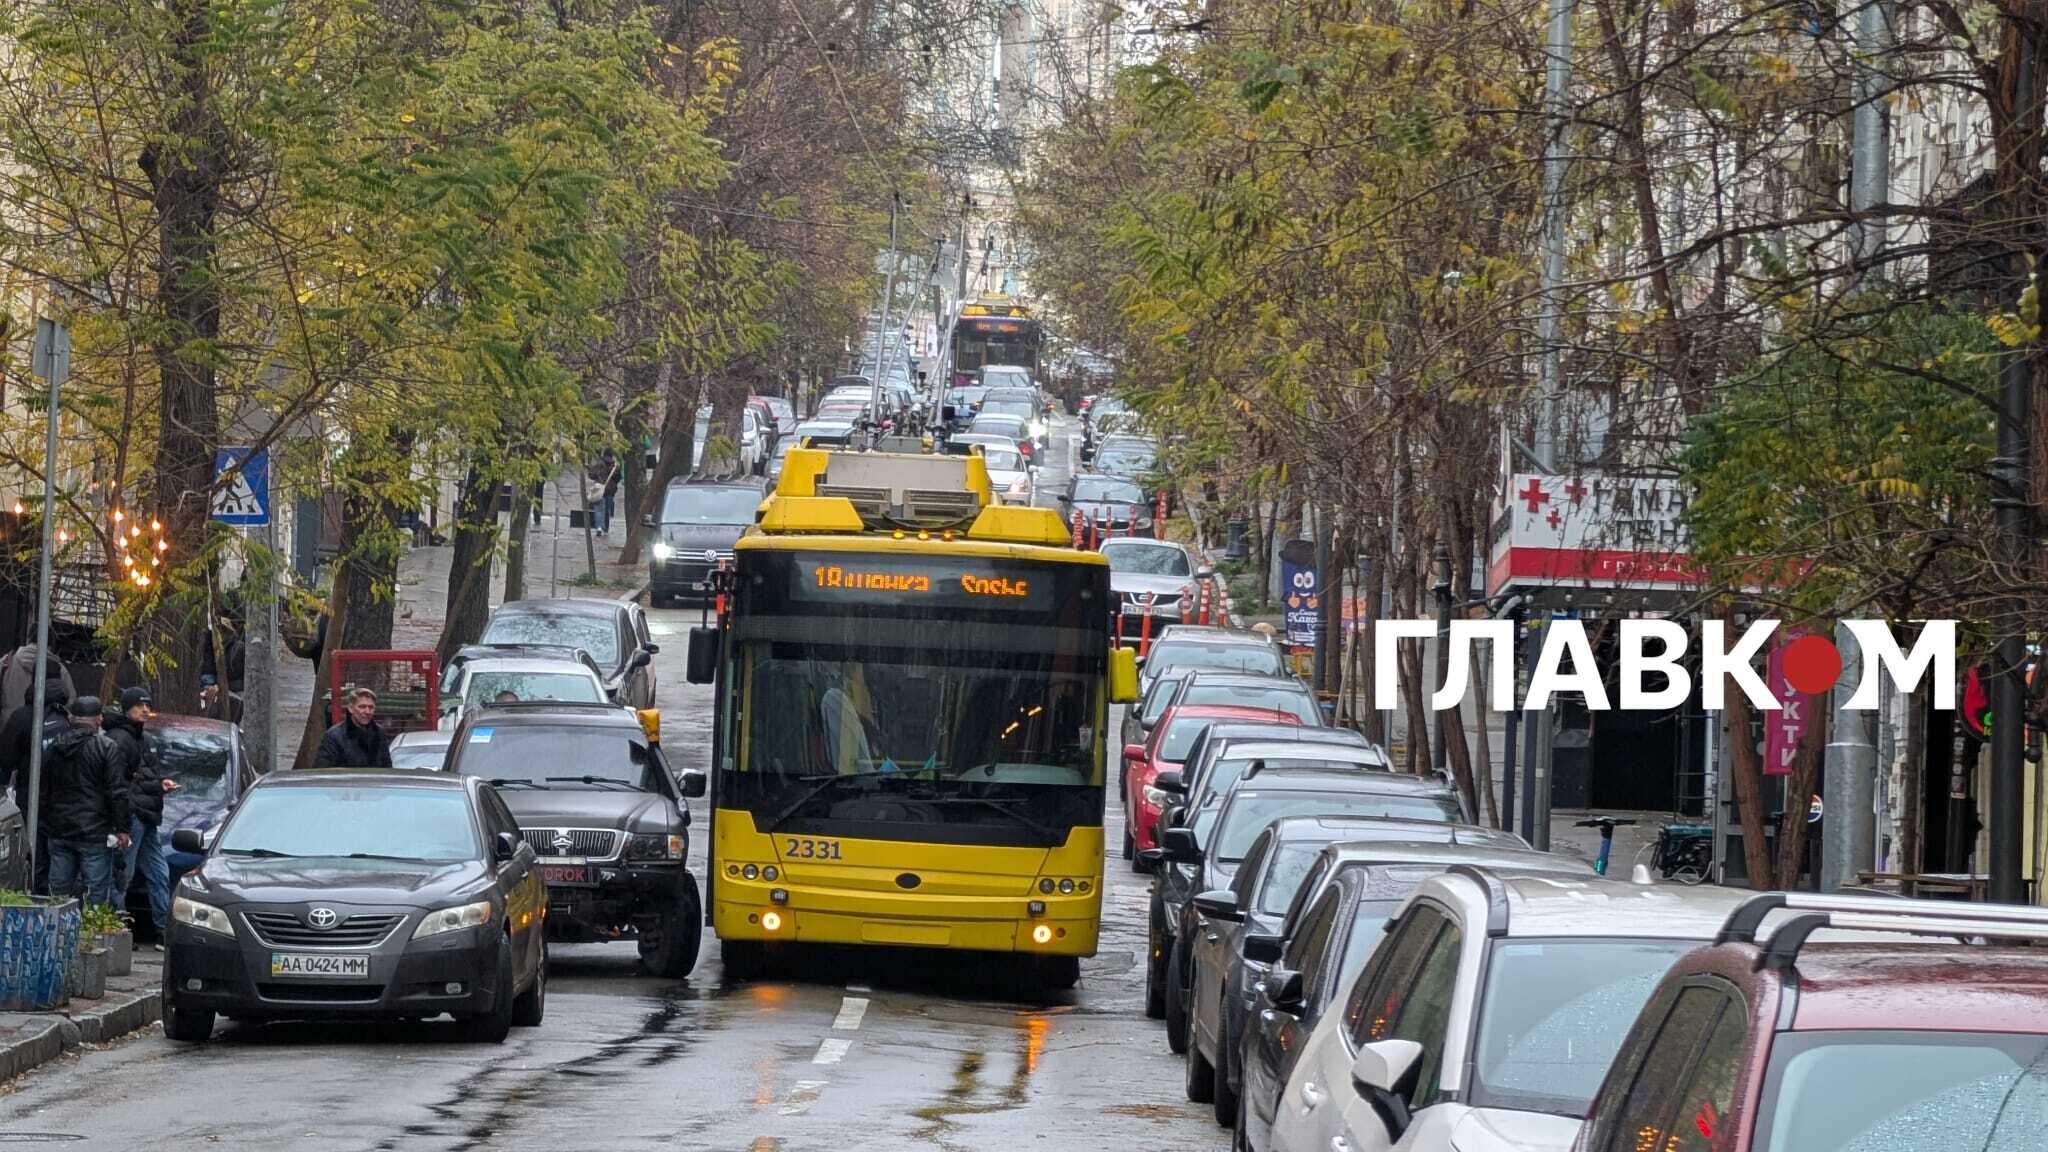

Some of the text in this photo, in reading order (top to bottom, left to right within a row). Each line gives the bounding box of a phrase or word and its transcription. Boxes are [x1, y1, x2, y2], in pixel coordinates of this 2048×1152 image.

[786, 838, 842, 860] 2331
[281, 956, 365, 973] AA 0424 MM
